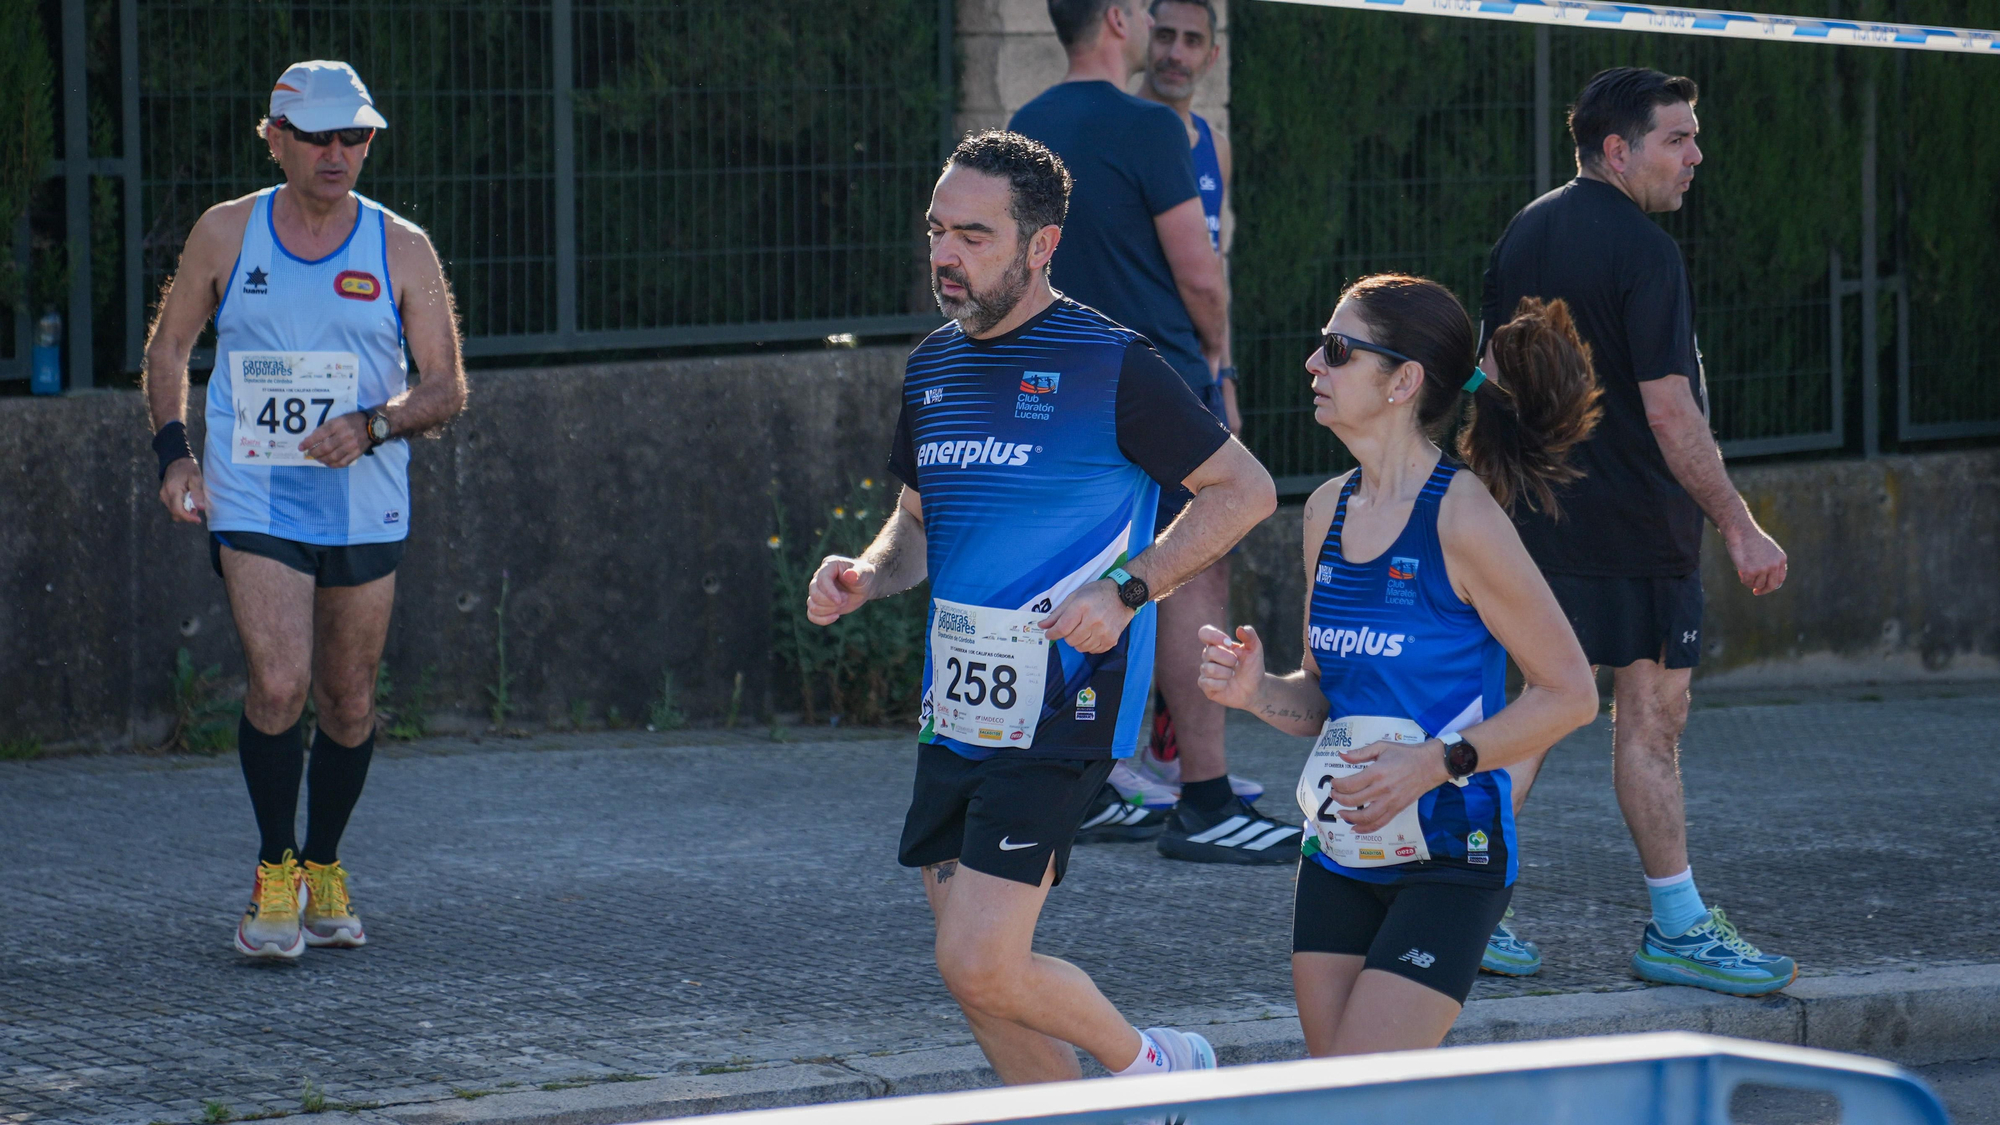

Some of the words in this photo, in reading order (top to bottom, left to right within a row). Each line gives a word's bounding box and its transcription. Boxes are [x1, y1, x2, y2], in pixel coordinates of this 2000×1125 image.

[243, 287, 268, 295] luanvi
[242, 360, 284, 369] carreras
[243, 366, 292, 377] populares
[1018, 393, 1039, 402] Club
[1016, 402, 1054, 412] Maratón
[256, 397, 334, 434] 487
[1014, 410, 1050, 420] Lucena
[1388, 580, 1405, 588] Club
[1386, 588, 1416, 598] Maratón
[1385, 596, 1414, 606] Lucena
[939, 610, 968, 625] carreras
[938, 618, 976, 635] populares
[946, 656, 1018, 710] 258
[981, 716, 1004, 724] IMDECO
